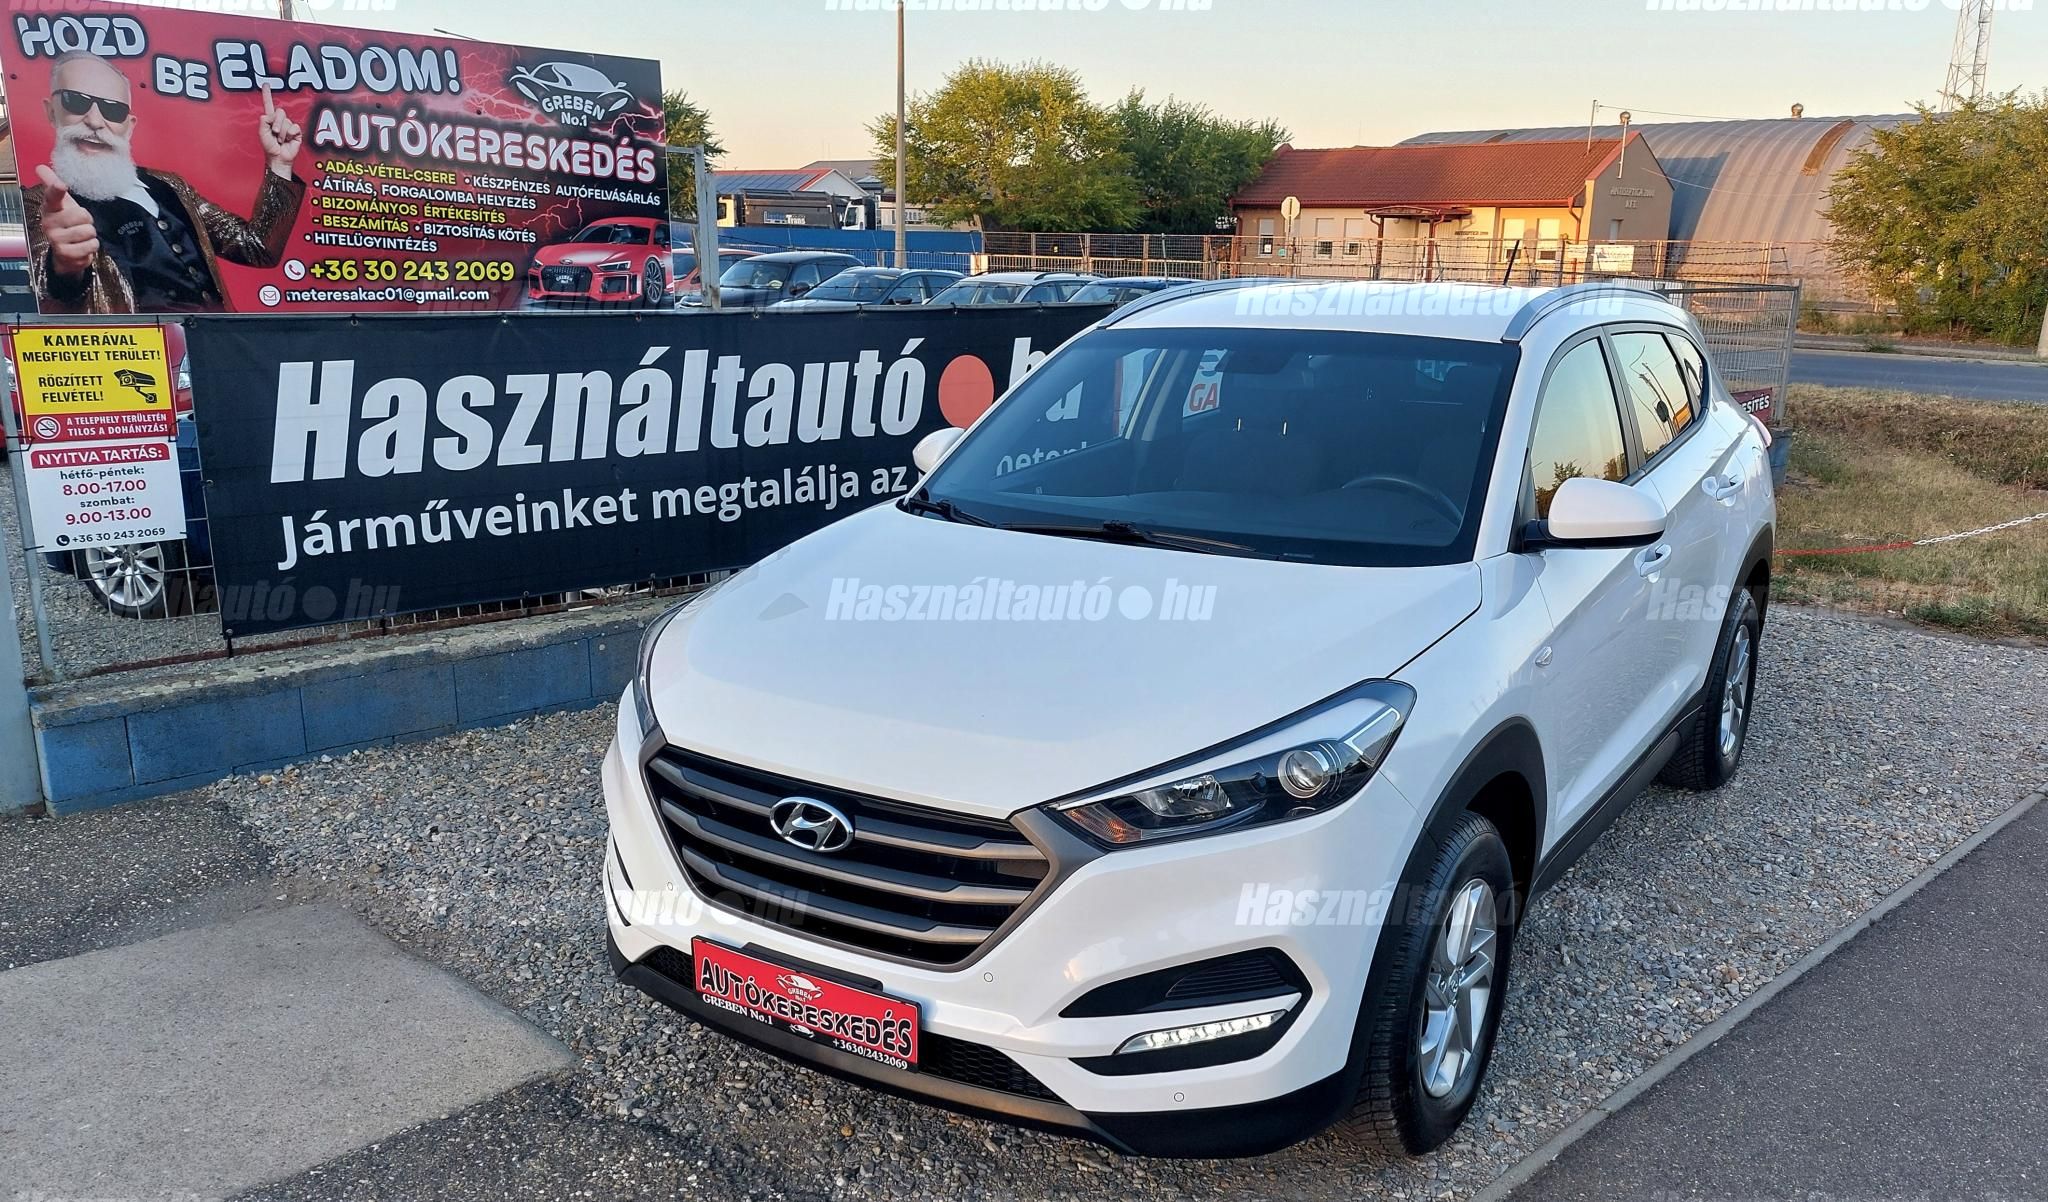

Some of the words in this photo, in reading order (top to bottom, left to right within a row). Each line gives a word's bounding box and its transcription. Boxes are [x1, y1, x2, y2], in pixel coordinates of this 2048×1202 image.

[16, 16, 145, 56] HOZD
[154, 57, 209, 99] BE
[215, 42, 461, 93] ELADOM!
[541, 95, 605, 120] GREBEN
[561, 112, 588, 127] No.1
[315, 108, 657, 183] AUTÓKERESKEDÉS
[325, 160, 456, 185] ADÁS-VÉTEL-CSERE
[322, 176, 377, 197] ÁTÍRÁS,
[381, 184, 474, 204] FORGALOMBA
[477, 193, 536, 210] HELYEZÉS
[473, 174, 550, 195] KÉSZPÉNZES
[555, 184, 661, 206] AUTÓFELVÁSÁRLÁS
[322, 196, 418, 216] BIZOMÁNYOS
[424, 205, 505, 224] ÉRTÉKESÍTÉS
[323, 215, 409, 232] BESZÁMÍTÁS
[424, 223, 495, 240] BIZTOSÍTÁS
[498, 227, 536, 243] KÖTÉS
[314, 233, 437, 252] HITELÜGYINTÉZÉS
[310, 260, 358, 281] +36
[364, 260, 397, 281] 30
[403, 261, 449, 281] 243
[455, 261, 515, 281] 2069
[43, 332, 137, 347] KAMERÁVAL
[22, 350, 100, 363] MEGFIGYELT
[106, 348, 161, 361] TERÜLET!
[38, 373, 103, 388] RÖGZÍTETT
[42, 389, 104, 403] FELVÉTEL!
[75, 415, 120, 425] TELEPHELY
[121, 413, 167, 424] TERÜLETÉN
[270, 337, 927, 483] Használtautó
[67, 428, 96, 437] TILOS
[98, 427, 105, 435] A
[108, 423, 168, 435] DOHÁNYZÁS!
[38, 451, 100, 466] NYITVA
[101, 446, 163, 462] TARTÁS:
[60, 466, 145, 481] hétfő-péntek:
[63, 479, 147, 496] 8.00-17.00
[80, 496, 135, 508] szombat:
[65, 507, 152, 526] 9.00-13.00
[277, 488, 638, 571] Járműveinket
[652, 465, 859, 522] megtalálja
[870, 466, 908, 495] az
[72, 534, 94, 543] +36
[97, 532, 111, 542] 30
[114, 531, 135, 540] 243
[137, 528, 166, 539] 2069
[701, 957, 913, 1058] AUTÓKERESKEDÉS
[702, 993, 748, 1017] GREBEN
[750, 1010, 773, 1026] No.1
[832, 1038, 908, 1071] +3630/2432069
